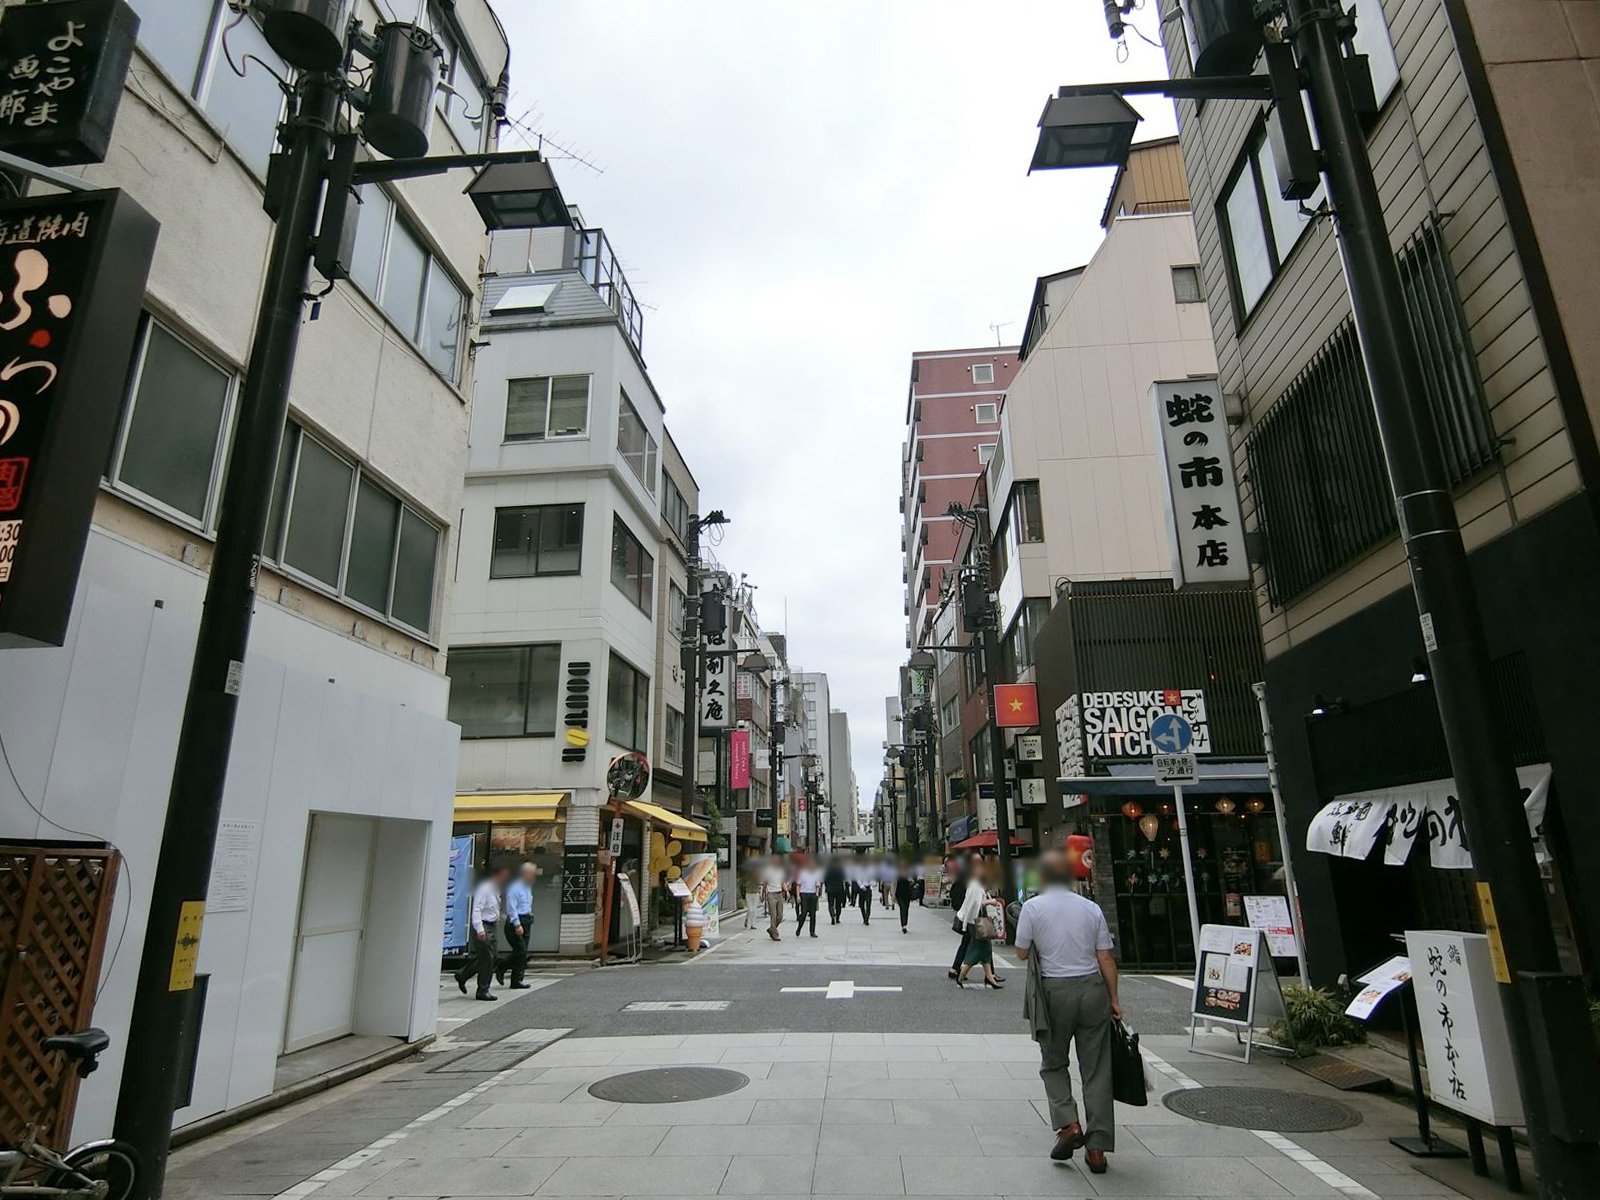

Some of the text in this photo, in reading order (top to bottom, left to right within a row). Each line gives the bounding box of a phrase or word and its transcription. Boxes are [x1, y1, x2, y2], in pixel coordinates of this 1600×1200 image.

[24, 21, 86, 127] よこやま
[1166, 393, 1230, 568] 蛇の市本店
[562, 661, 591, 763] DOUTOR
[1082, 690, 1165, 708] DEDESUKE
[1084, 706, 1184, 734] SAIGO
[1086, 731, 1188, 757] KITCH
[1157, 757, 1192, 767] 自転車を除く
[1158, 766, 1193, 775] 一方通行
[1427, 945, 1468, 1100] 蛇の市本店
